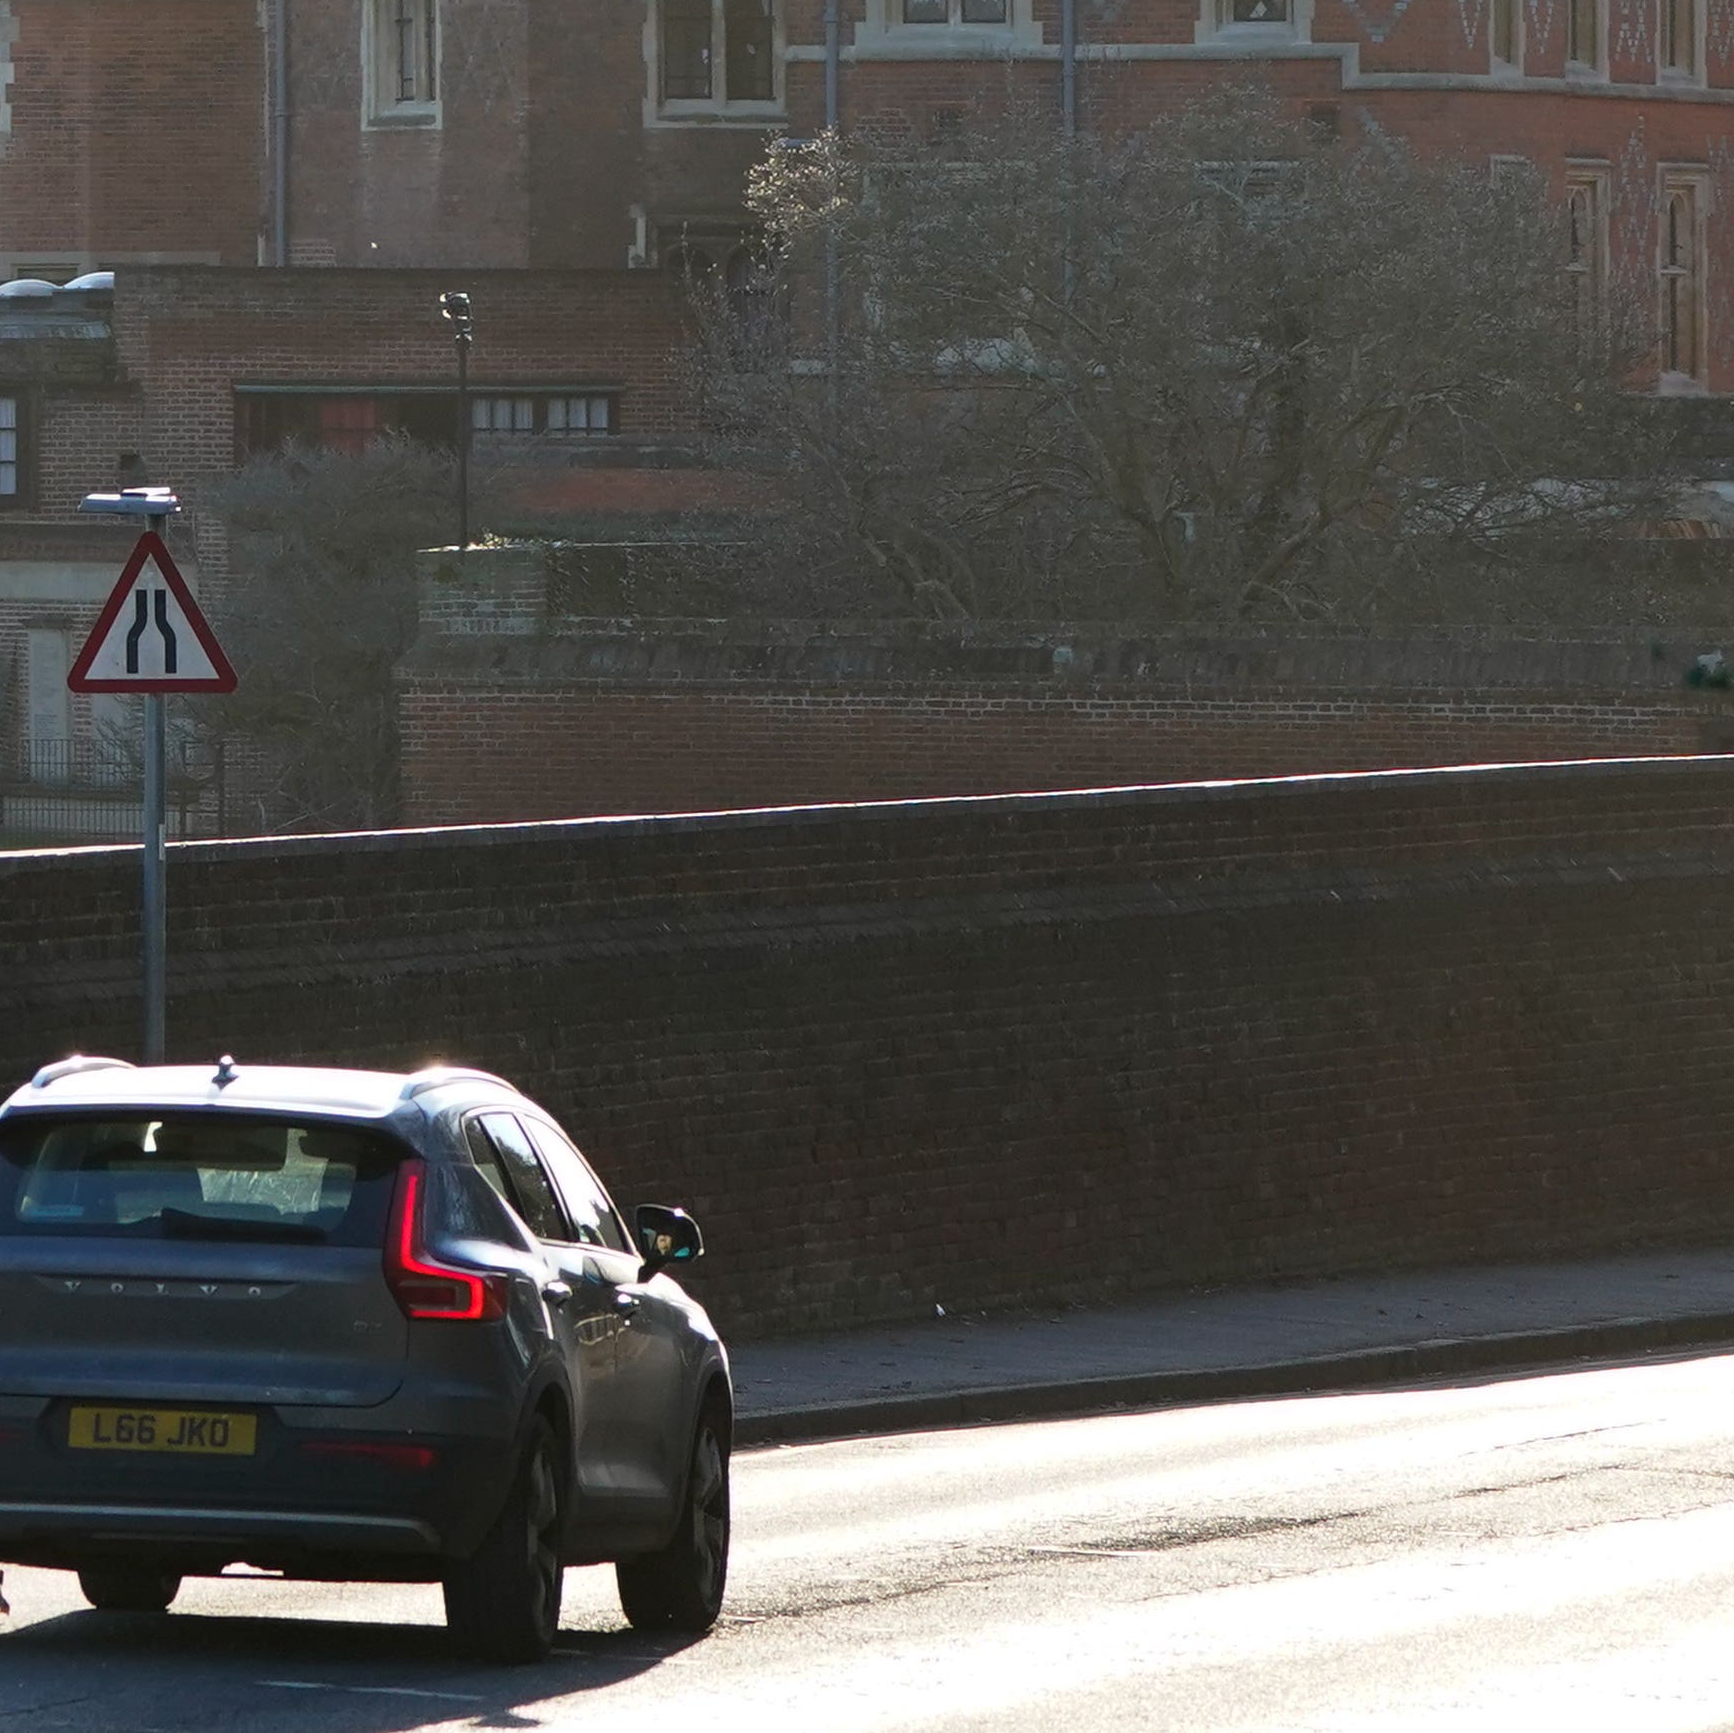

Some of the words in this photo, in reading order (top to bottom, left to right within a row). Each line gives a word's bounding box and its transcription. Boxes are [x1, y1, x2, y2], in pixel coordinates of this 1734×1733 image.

[64, 1281, 261, 1297] VOLVO
[93, 1412, 156, 1444] L66
[167, 1416, 230, 1448] JKO
